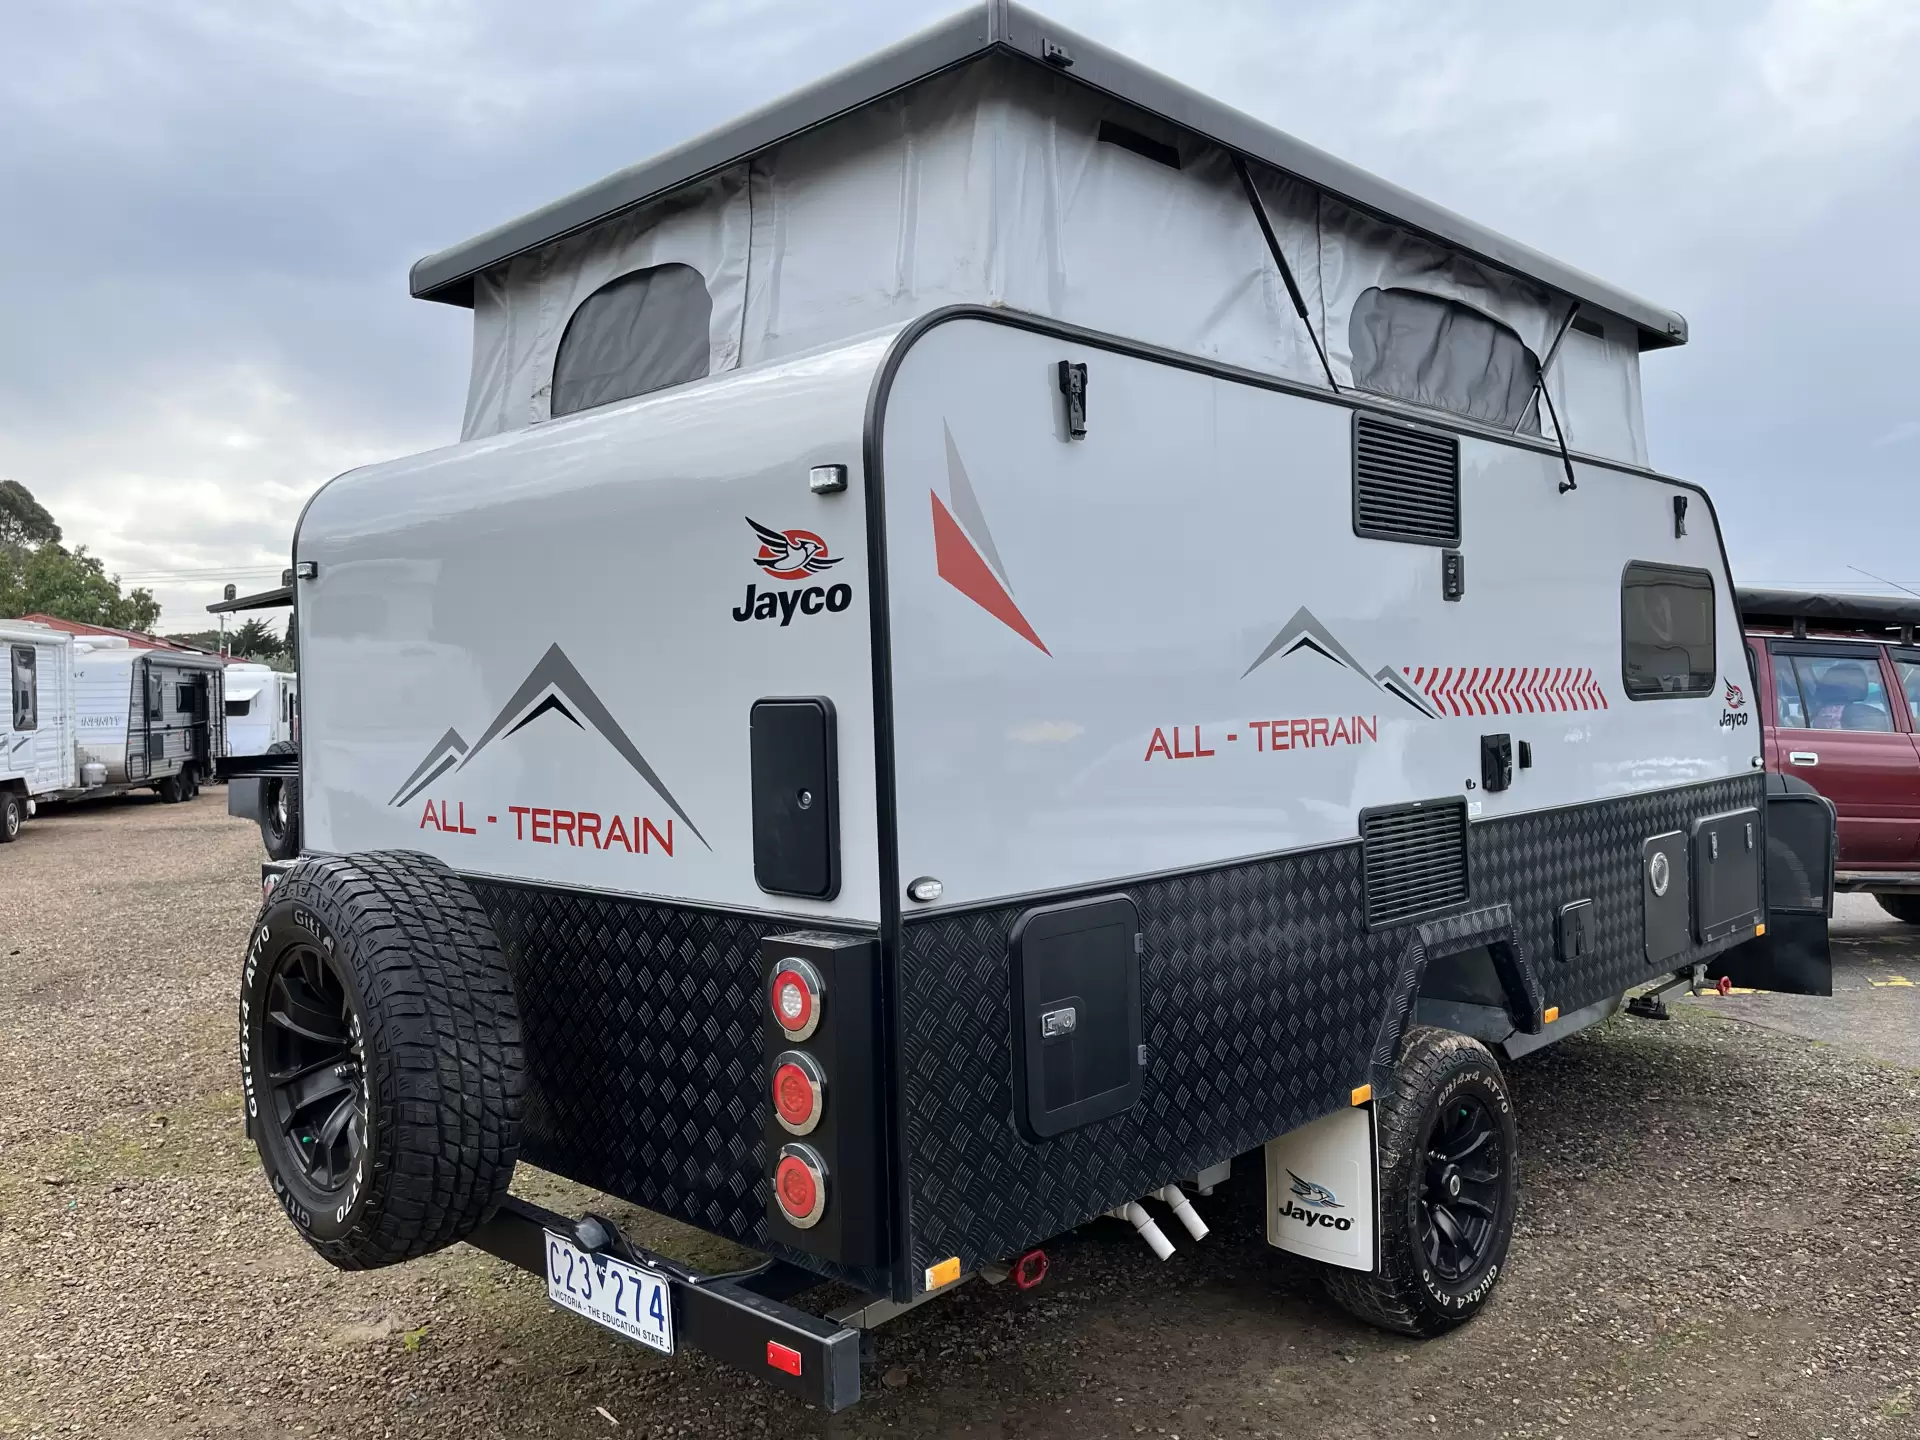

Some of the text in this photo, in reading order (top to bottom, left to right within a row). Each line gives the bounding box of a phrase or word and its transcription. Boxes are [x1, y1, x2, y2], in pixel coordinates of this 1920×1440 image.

[732, 583, 852, 627] Jayco
[81, 716, 120, 726] INFINITY
[1144, 724, 1215, 761] ALL
[1249, 715, 1377, 752] TERRAIN
[1719, 708, 1748, 731] Jayco
[420, 799, 476, 835] ALL
[508, 805, 674, 858] TERRAIN
[294, 909, 320, 938] Giti
[246, 925, 270, 988] AT70
[1482, 1076, 1509, 1114] AT70
[1278, 1200, 1351, 1231] Jayco
[550, 1241, 665, 1333] C23 274
[1422, 1269, 1451, 1306] AT70
[554, 1288, 582, 1311] VICTORIA
[588, 1305, 601, 1319] THE
[602, 1312, 641, 1337] EDUCATION
[642, 1330, 664, 1346] STATE
